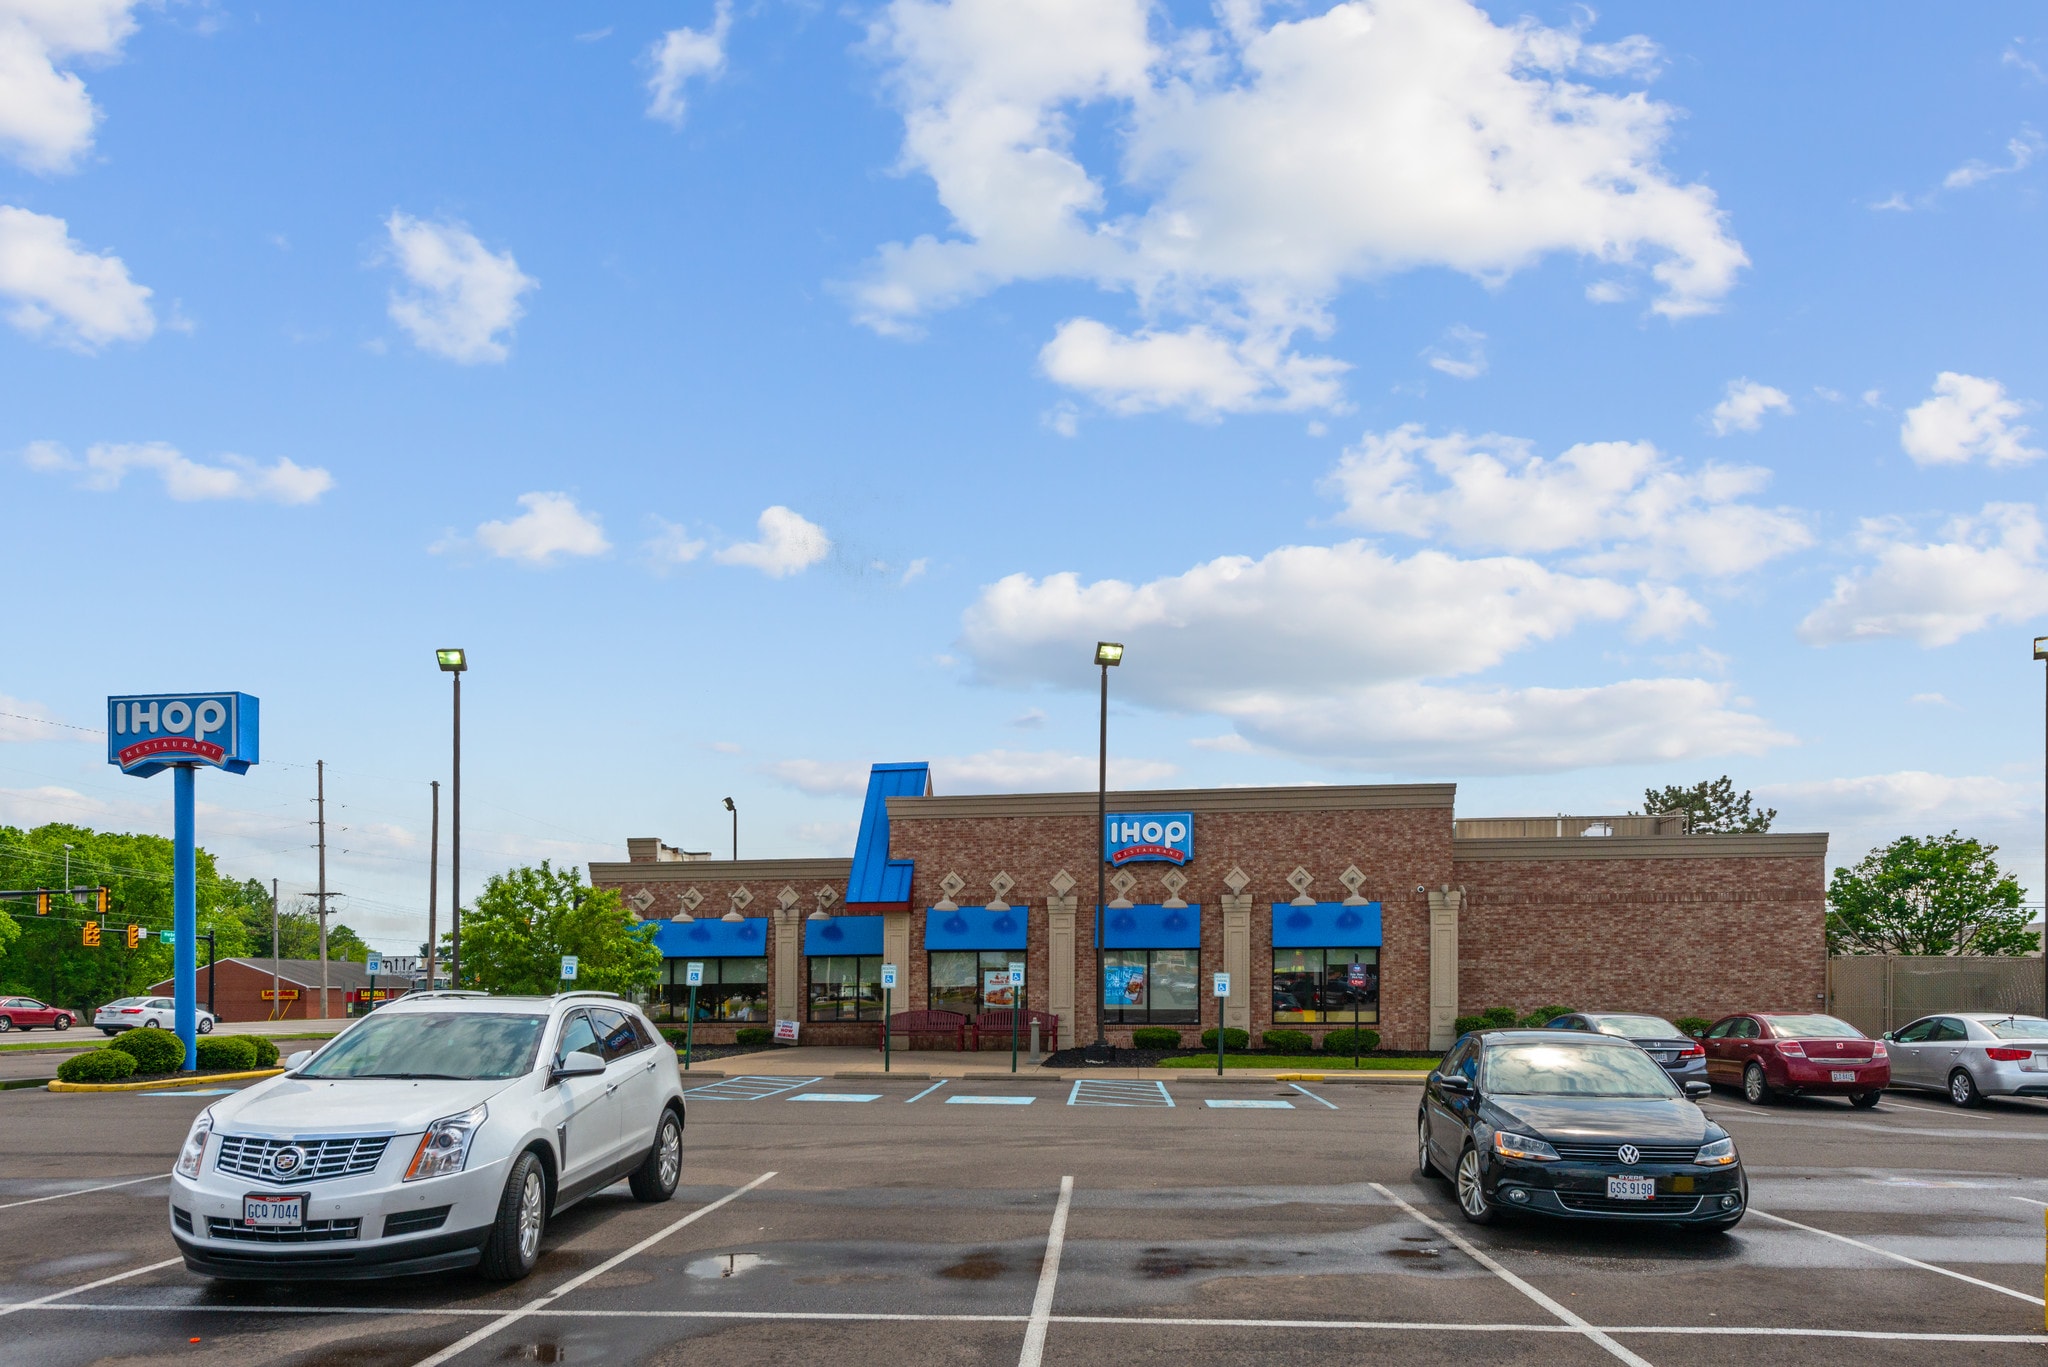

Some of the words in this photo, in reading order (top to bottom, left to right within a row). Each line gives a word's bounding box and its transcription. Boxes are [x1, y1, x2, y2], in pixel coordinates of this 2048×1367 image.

[116, 700, 227, 742] IHOP
[125, 741, 217, 758] RESTAURANT
[1110, 821, 1187, 849] IHOP
[1116, 847, 1180, 859] RESTAURANT
[1610, 1181, 1628, 1194] GSS
[1629, 1182, 1653, 1195] 9198
[247, 1203, 269, 1219] GCQ
[271, 1204, 299, 1219] 7044
